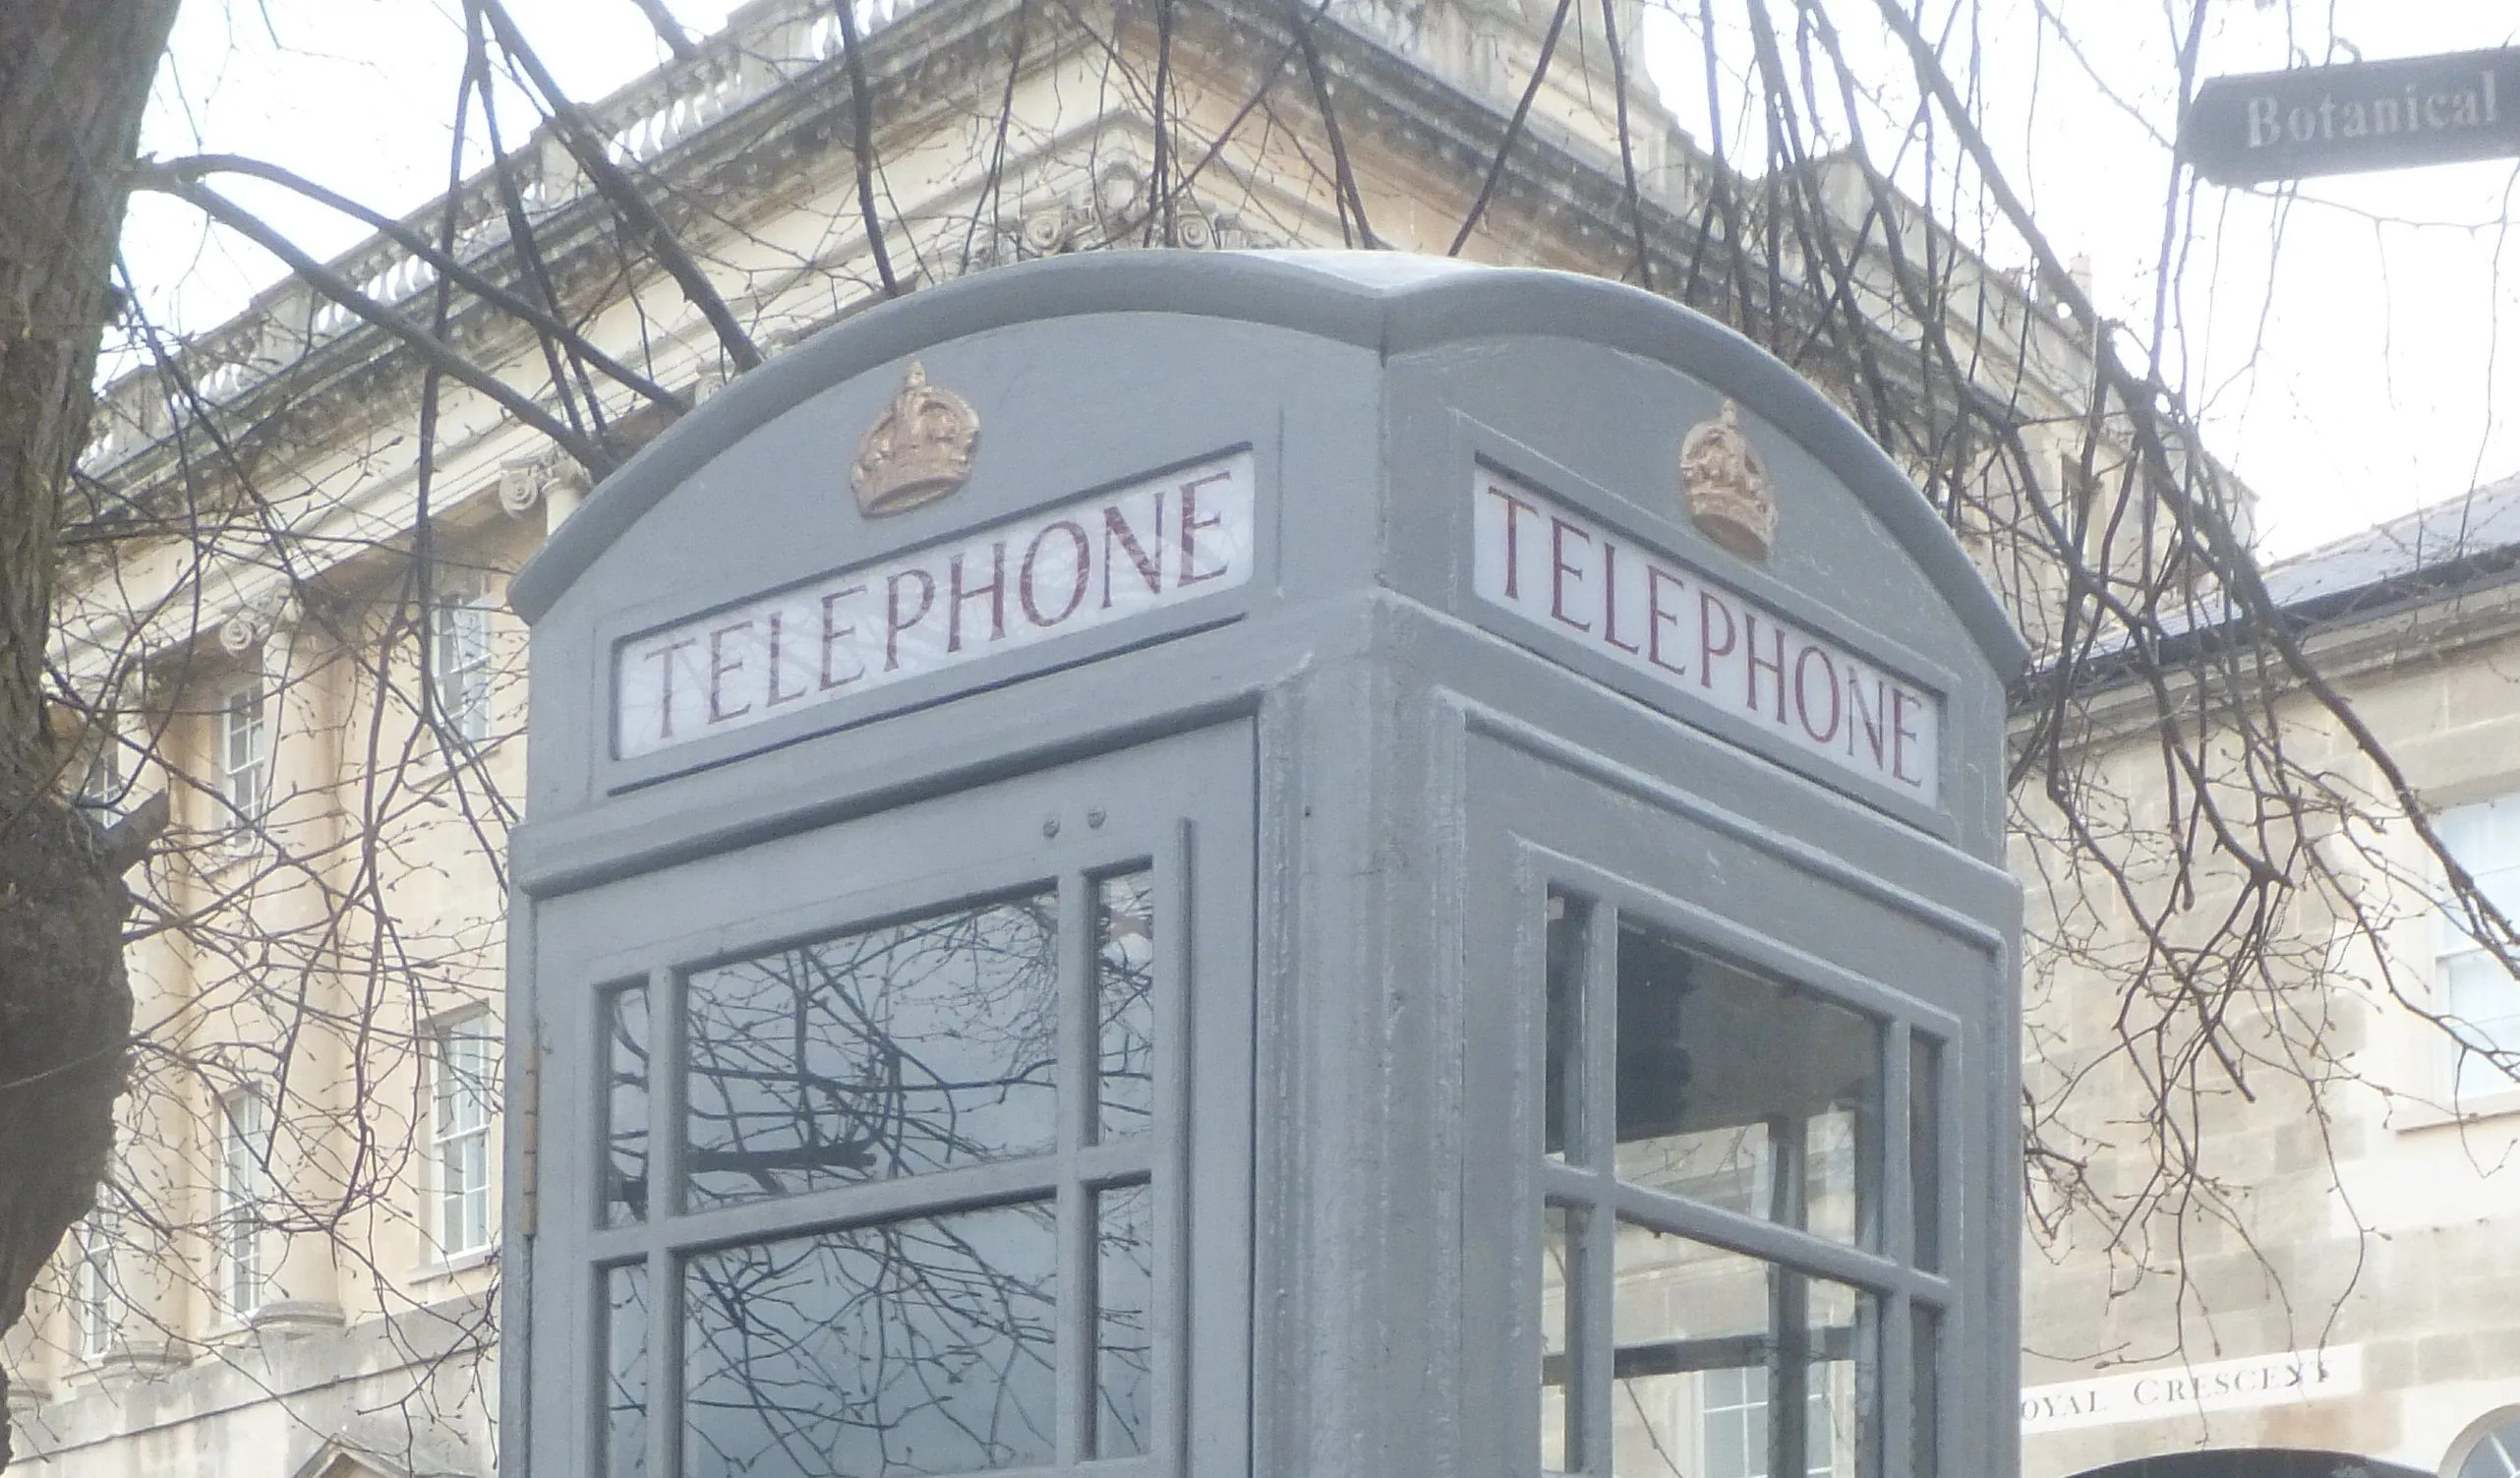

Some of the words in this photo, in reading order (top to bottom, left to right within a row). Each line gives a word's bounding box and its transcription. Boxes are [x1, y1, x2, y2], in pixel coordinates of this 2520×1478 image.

[2248, 70, 2496, 148] Botanical
[644, 469, 1232, 739] TELEPHONE
[1487, 485, 1922, 788] TELEPHONE
[2021, 1389, 2108, 1422] OYAL
[2134, 1359, 2333, 1406] CRESCENT
